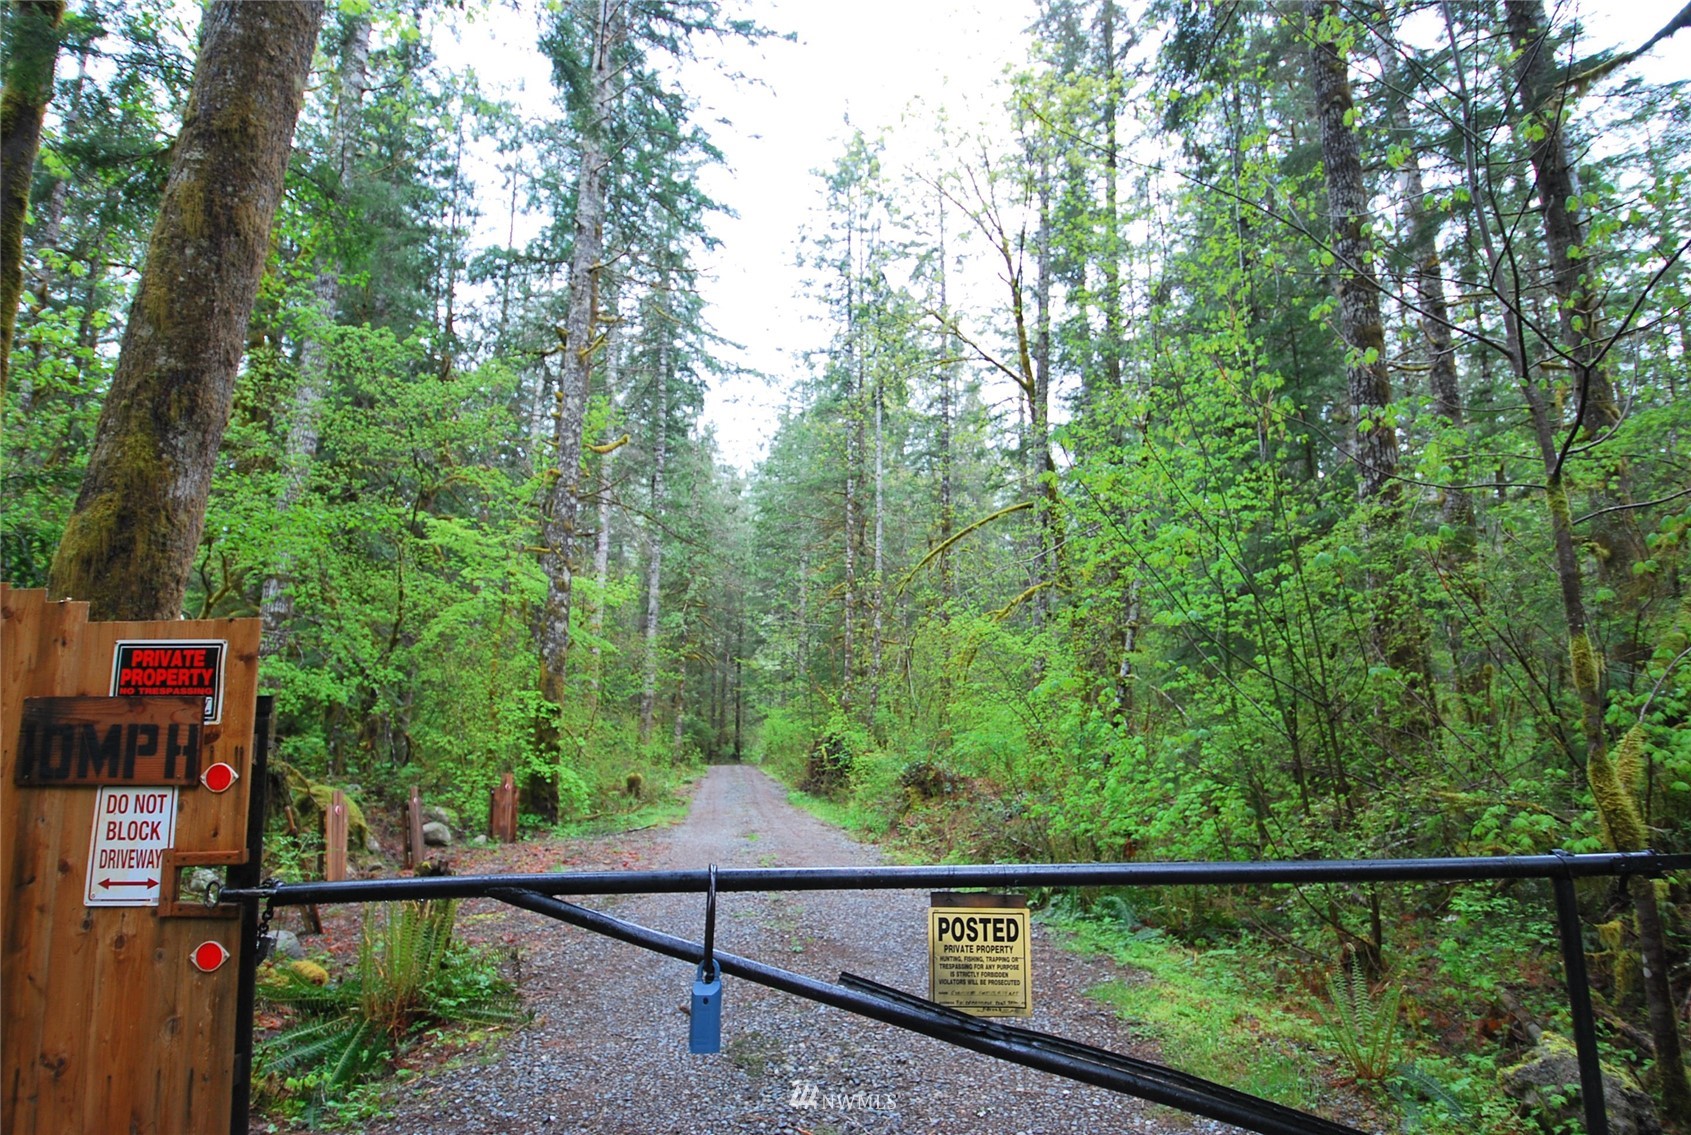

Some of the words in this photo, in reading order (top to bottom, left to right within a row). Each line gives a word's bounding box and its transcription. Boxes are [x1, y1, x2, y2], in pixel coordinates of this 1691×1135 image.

[131, 650, 206, 667] PRIVATE
[120, 668, 214, 686] PROPERTY
[119, 687, 135, 695] NO
[138, 687, 213, 695] TRESPASSING
[106, 794, 129, 814] DO
[133, 794, 167, 814] NOT
[106, 821, 161, 840] BLOCK
[99, 849, 162, 868] DRIVEWAY
[938, 917, 1019, 942] POSTED
[943, 944, 974, 953] PRIVATE
[976, 945, 1014, 954] PROPERTY
